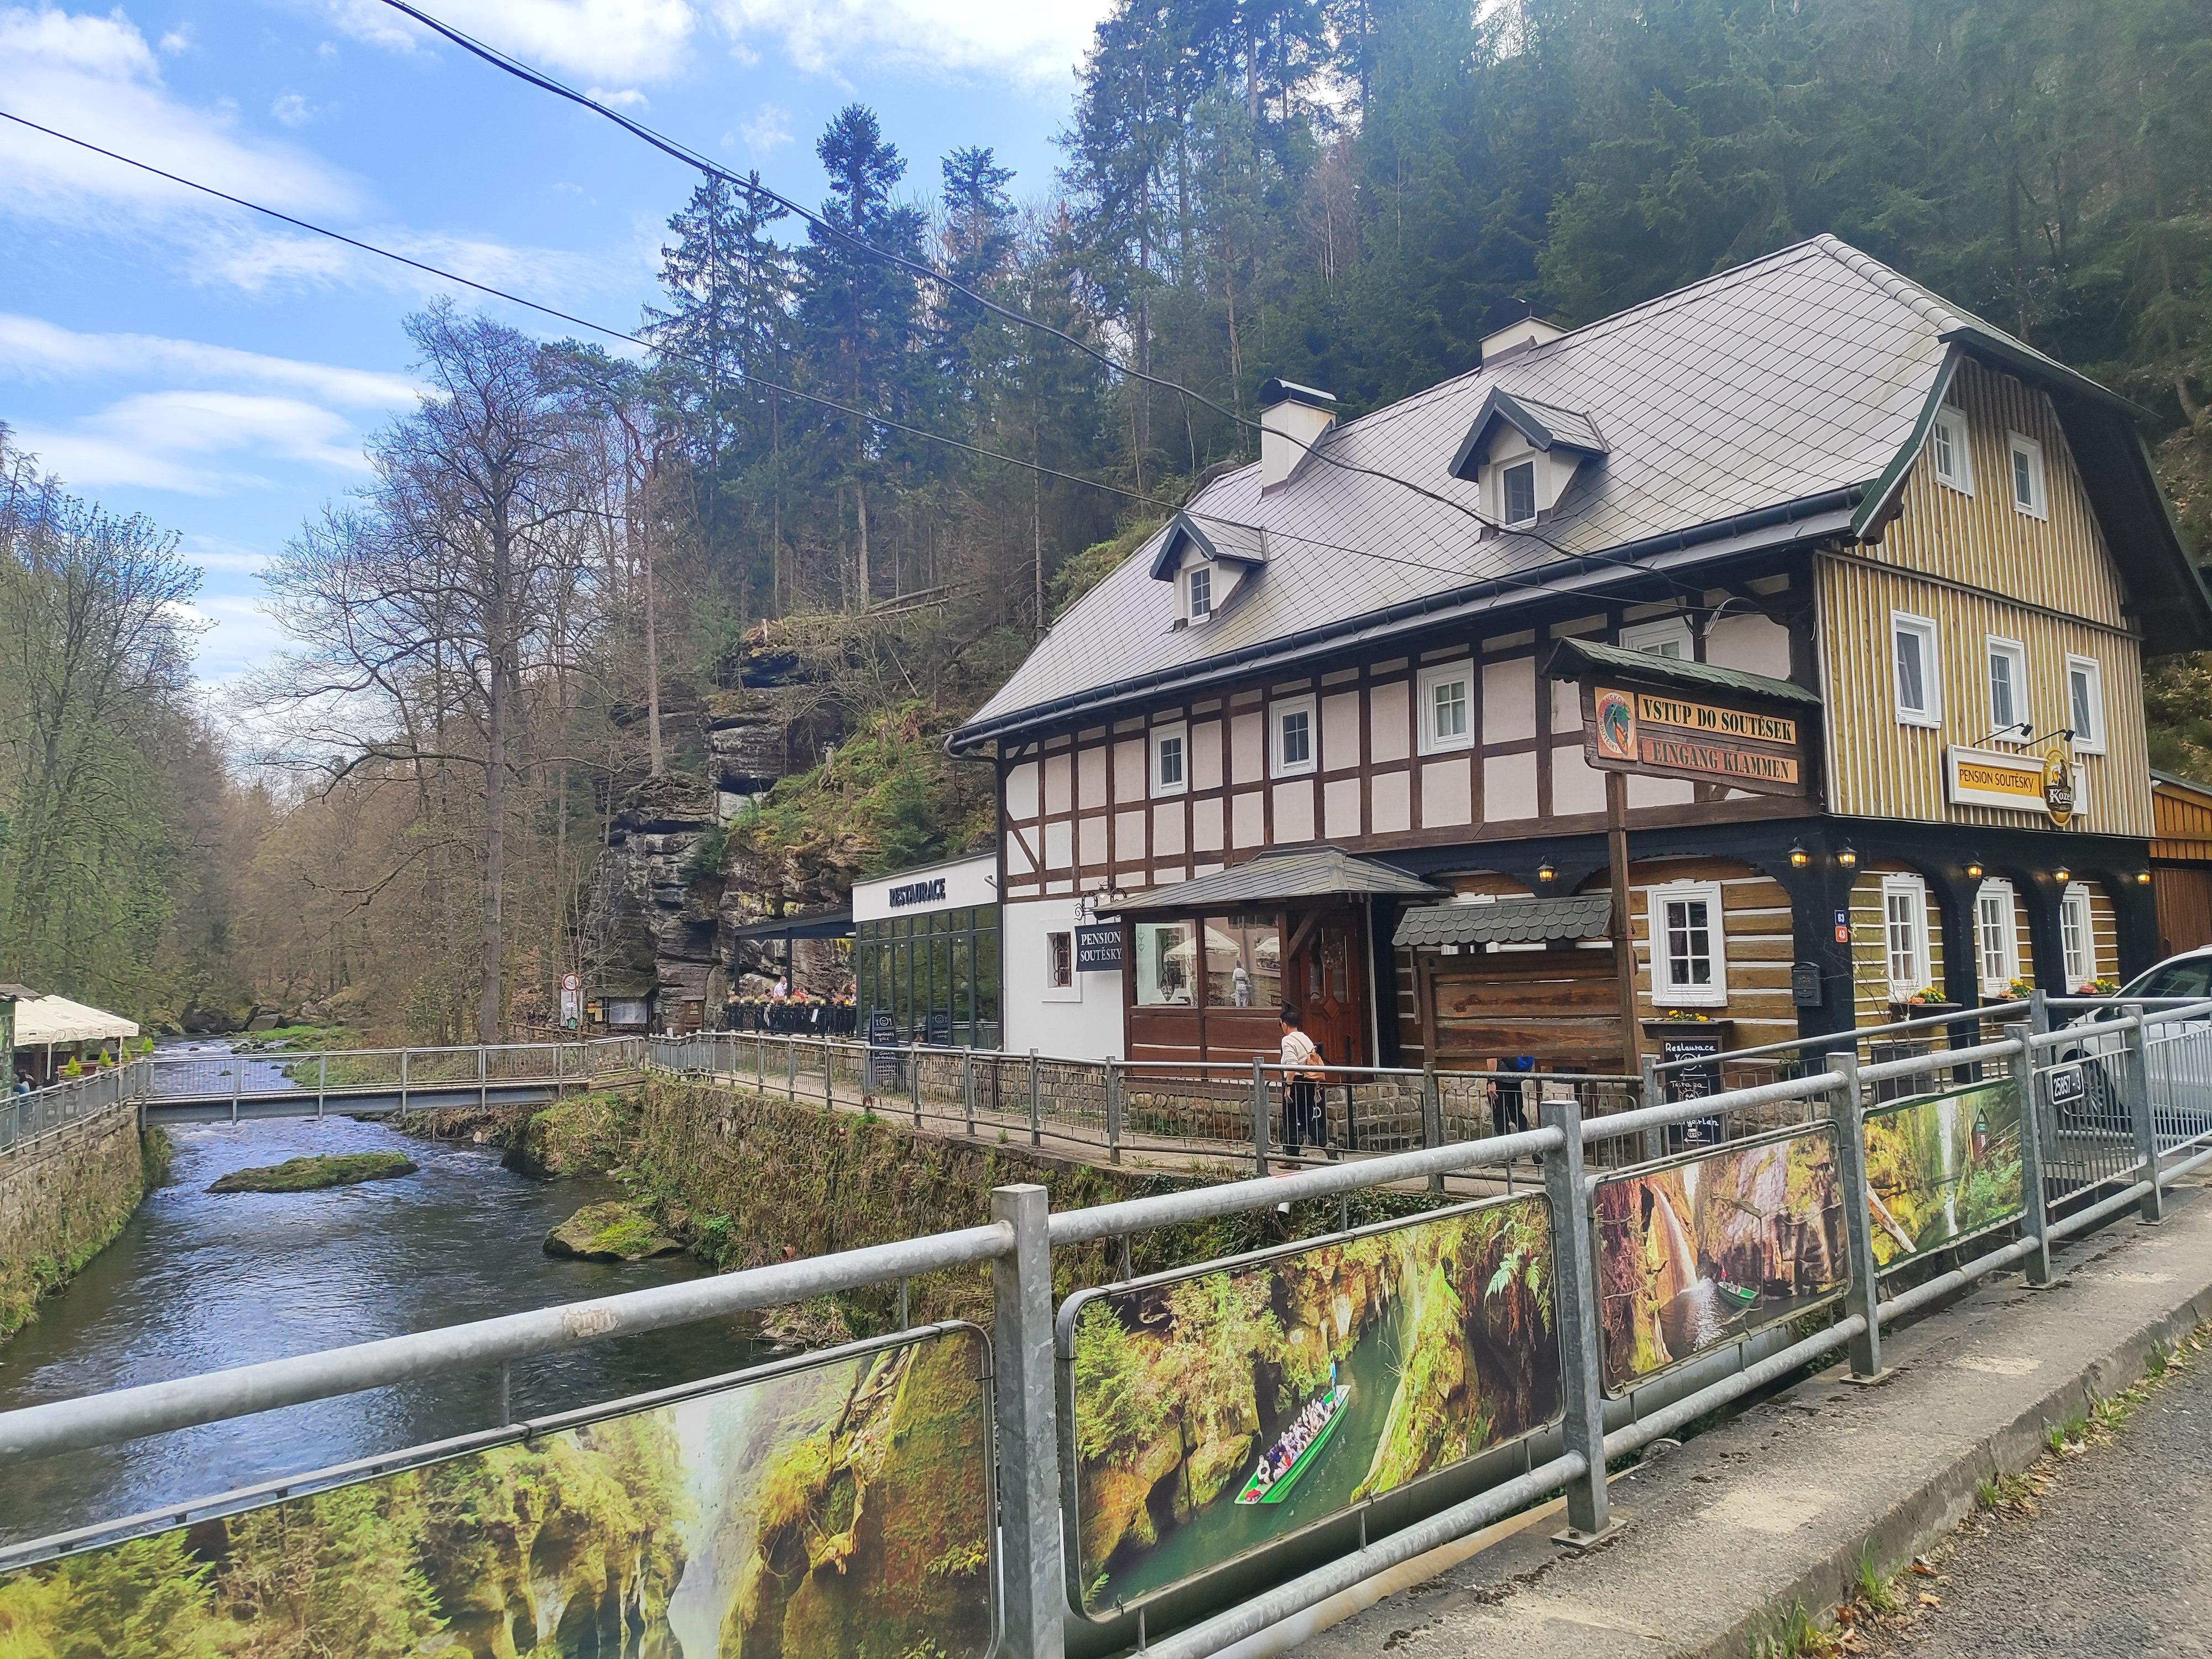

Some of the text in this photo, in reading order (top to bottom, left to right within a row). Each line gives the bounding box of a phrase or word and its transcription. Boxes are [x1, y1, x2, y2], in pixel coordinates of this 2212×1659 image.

[1643, 698, 1792, 741] VSTUP DO SOUTĚSEK
[1652, 742, 1788, 779] EINGANG KLAMMEN
[1959, 769, 2034, 792] PENSION SOUTĚSKY
[889, 878, 946, 907] RESTAURACE
[1081, 931, 1121, 946] PENSION
[1080, 946, 1123, 962] SOUTĚSKY
[1665, 1042, 1716, 1052] Restaurace
[2053, 1074, 2070, 1097] 25857
